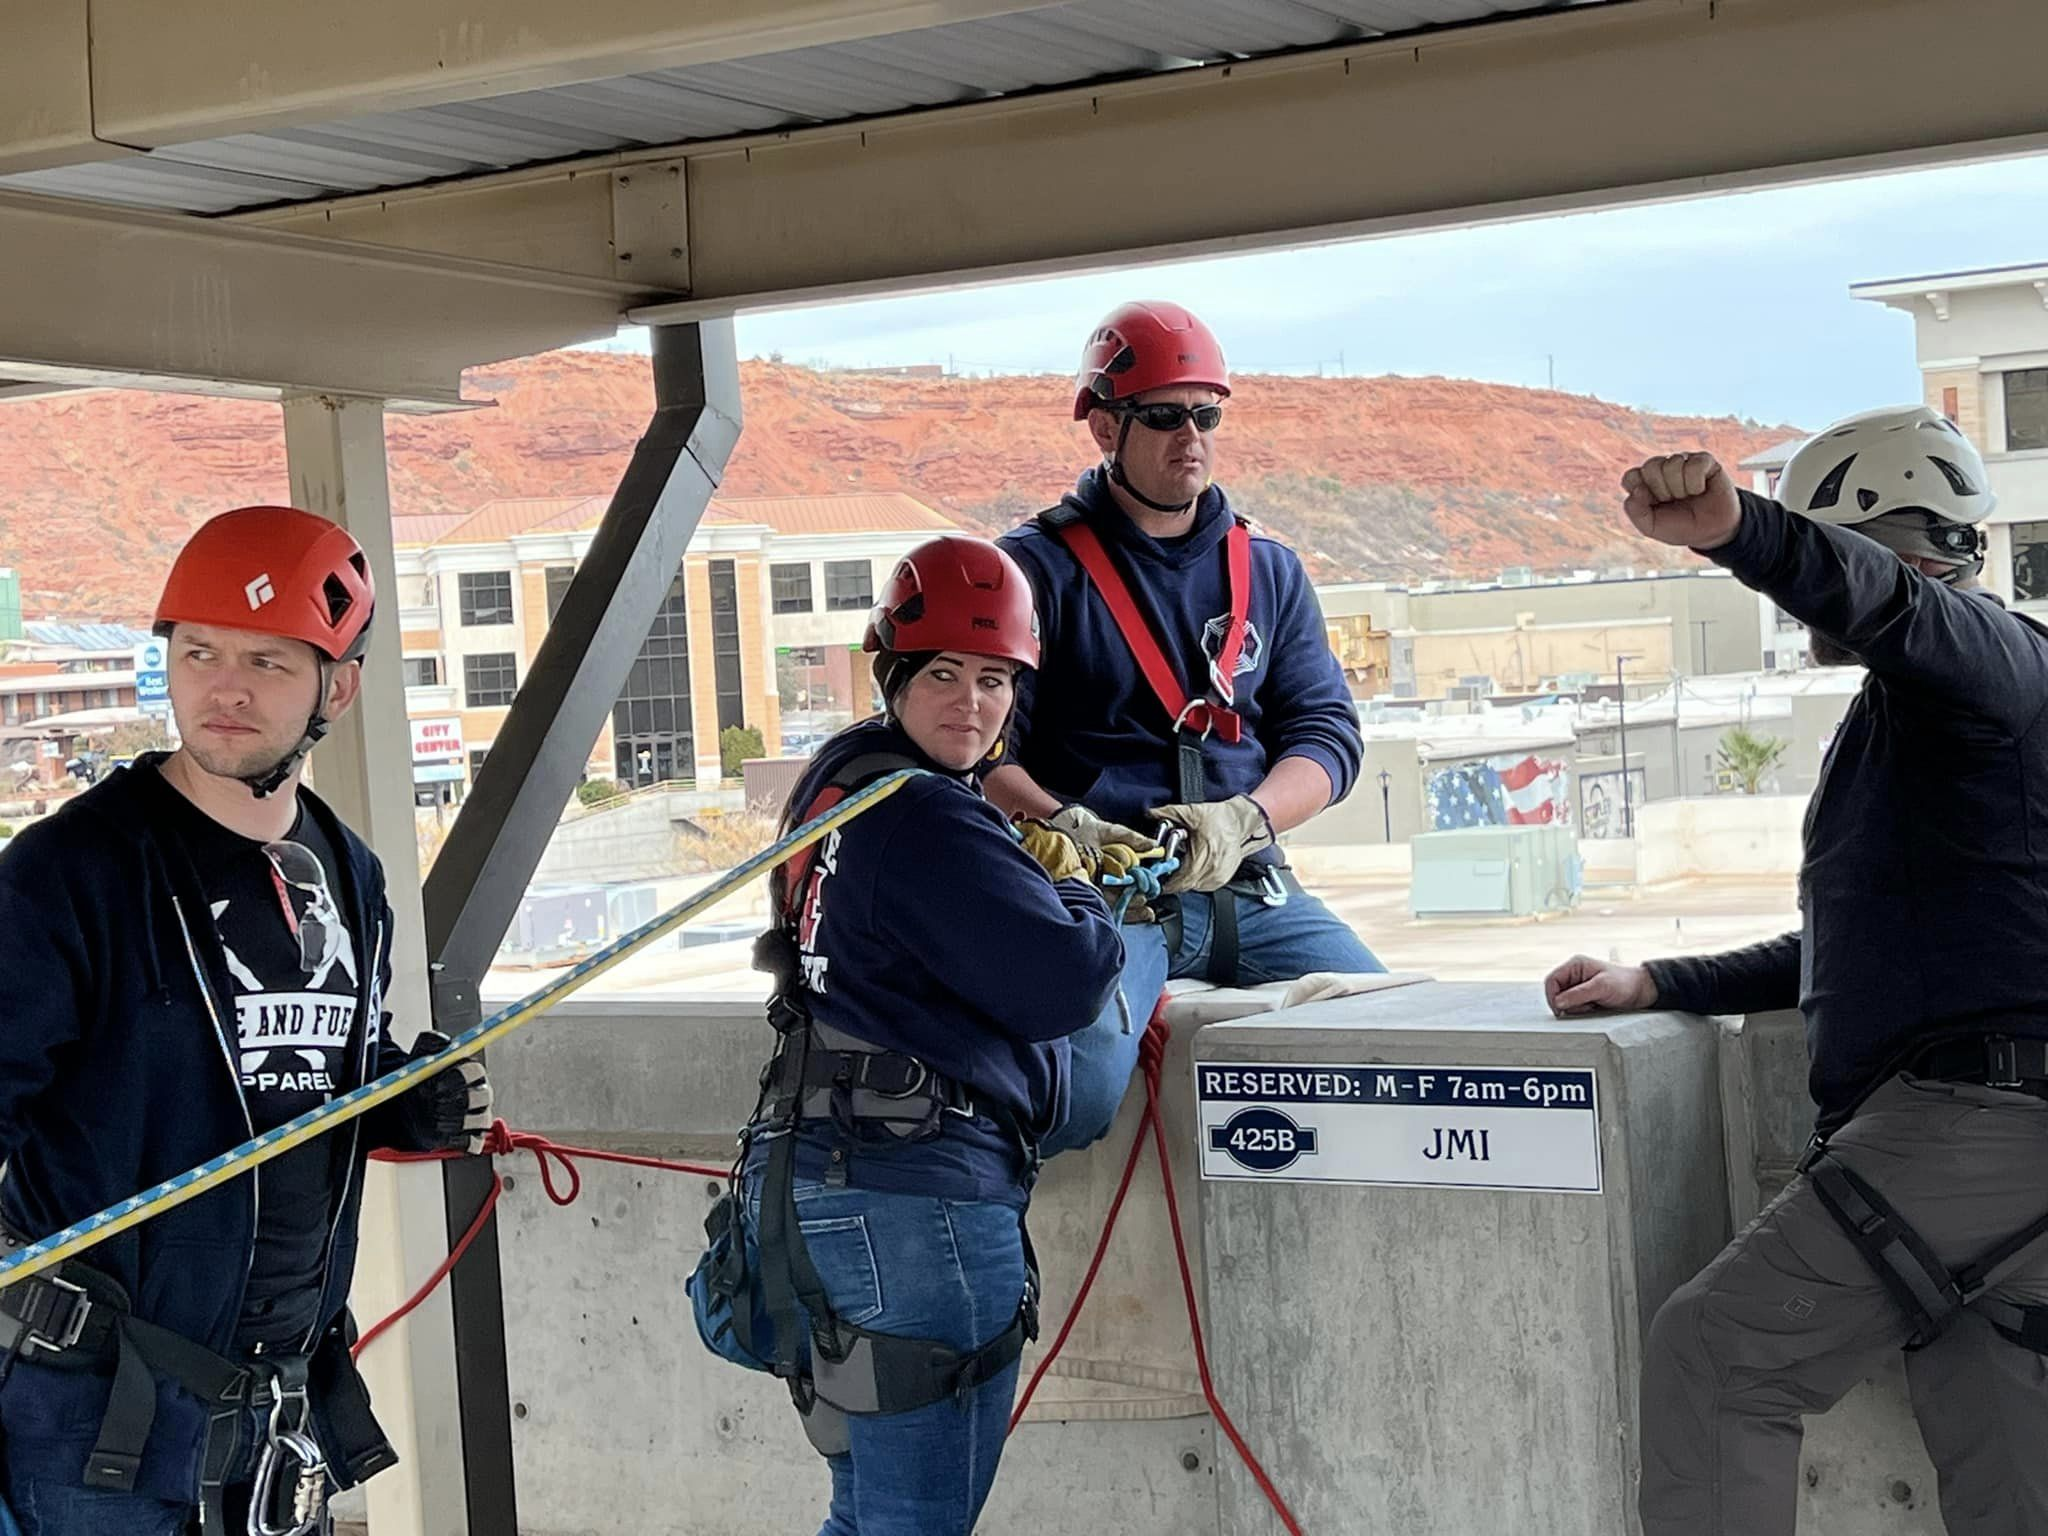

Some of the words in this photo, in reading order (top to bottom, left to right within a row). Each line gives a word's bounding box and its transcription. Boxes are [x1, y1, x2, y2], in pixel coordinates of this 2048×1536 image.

[422, 724, 450, 737] CITY
[415, 739, 461, 754] CENTER
[256, 1004, 304, 1037] AND
[1205, 1071, 1361, 1097] RESERVED:
[1375, 1074, 1436, 1099] M-F
[1447, 1075, 1587, 1107] 7am-6pm
[1230, 1127, 1296, 1152] 425B
[1422, 1127, 1490, 1161] JMI
